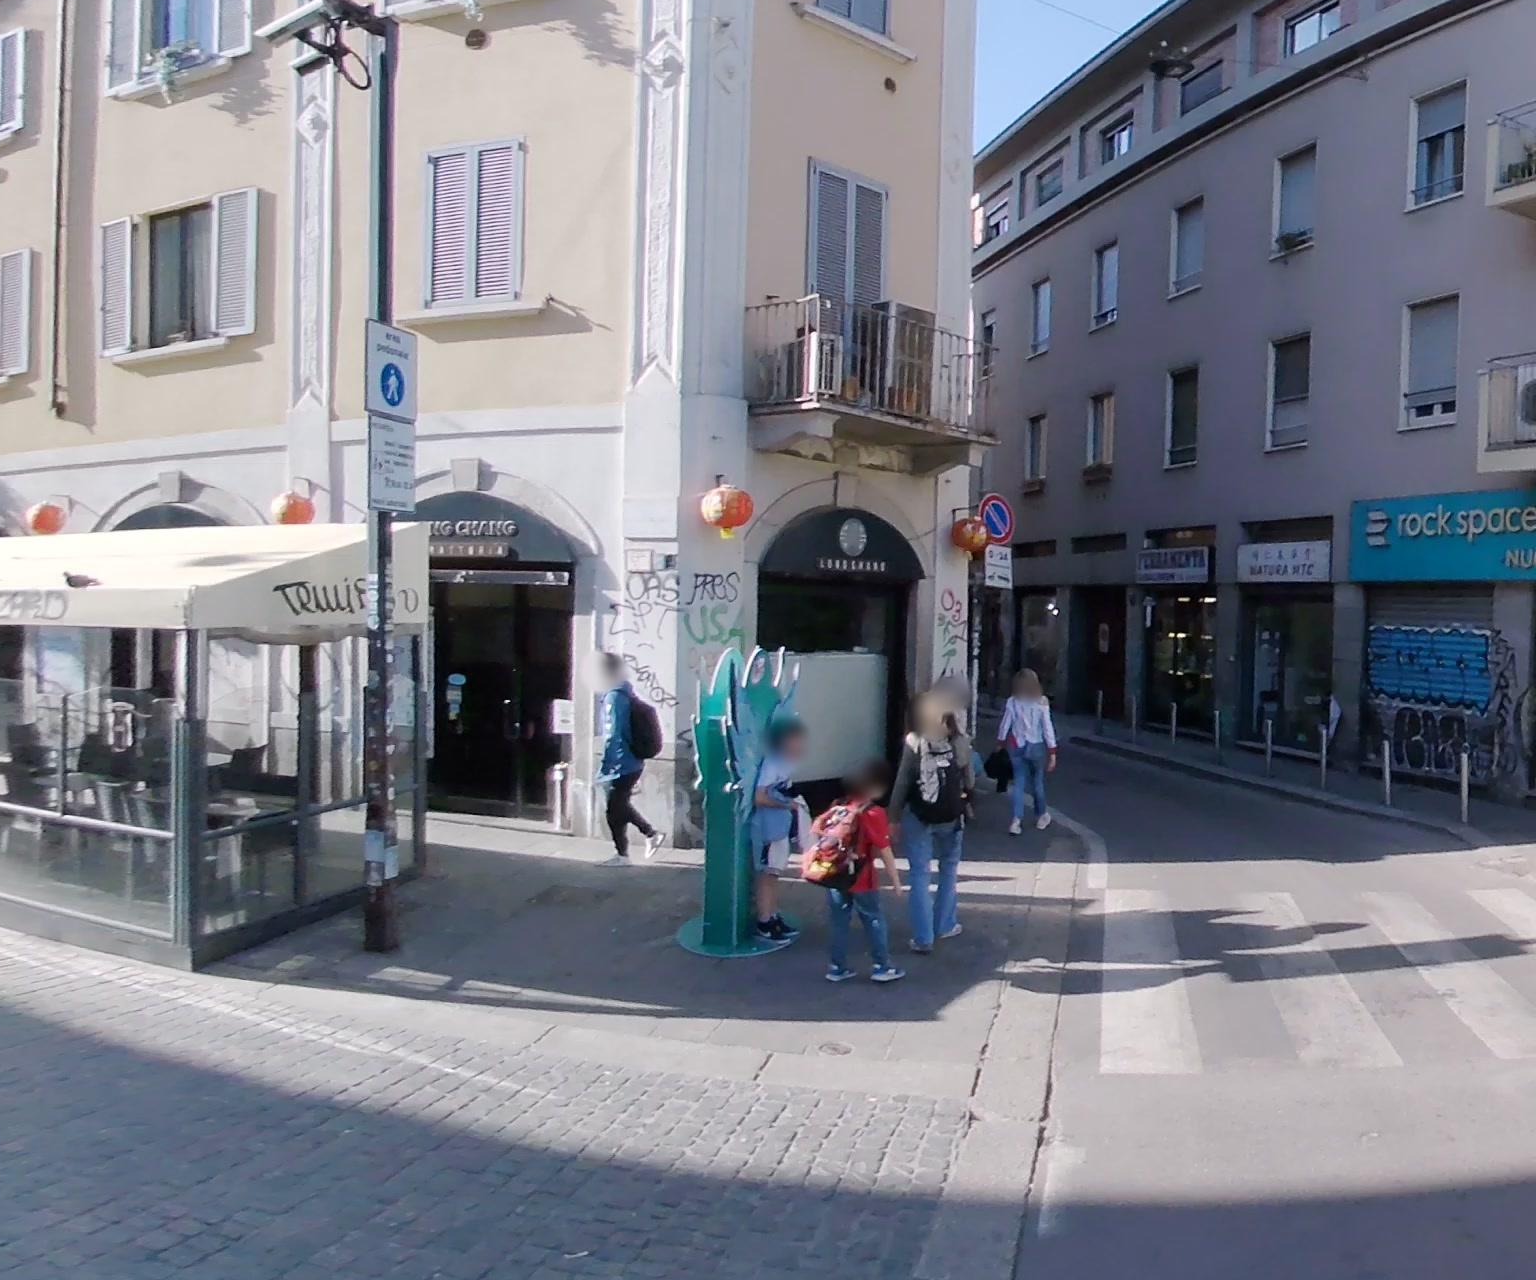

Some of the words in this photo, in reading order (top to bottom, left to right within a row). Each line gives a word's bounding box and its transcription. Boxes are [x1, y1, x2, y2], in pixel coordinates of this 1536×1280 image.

[456, 520, 518, 537] CHANG
[1397, 504, 1452, 537] rock
[1456, 505, 1536, 543] space
[1504, 549, 1536, 569] NU
